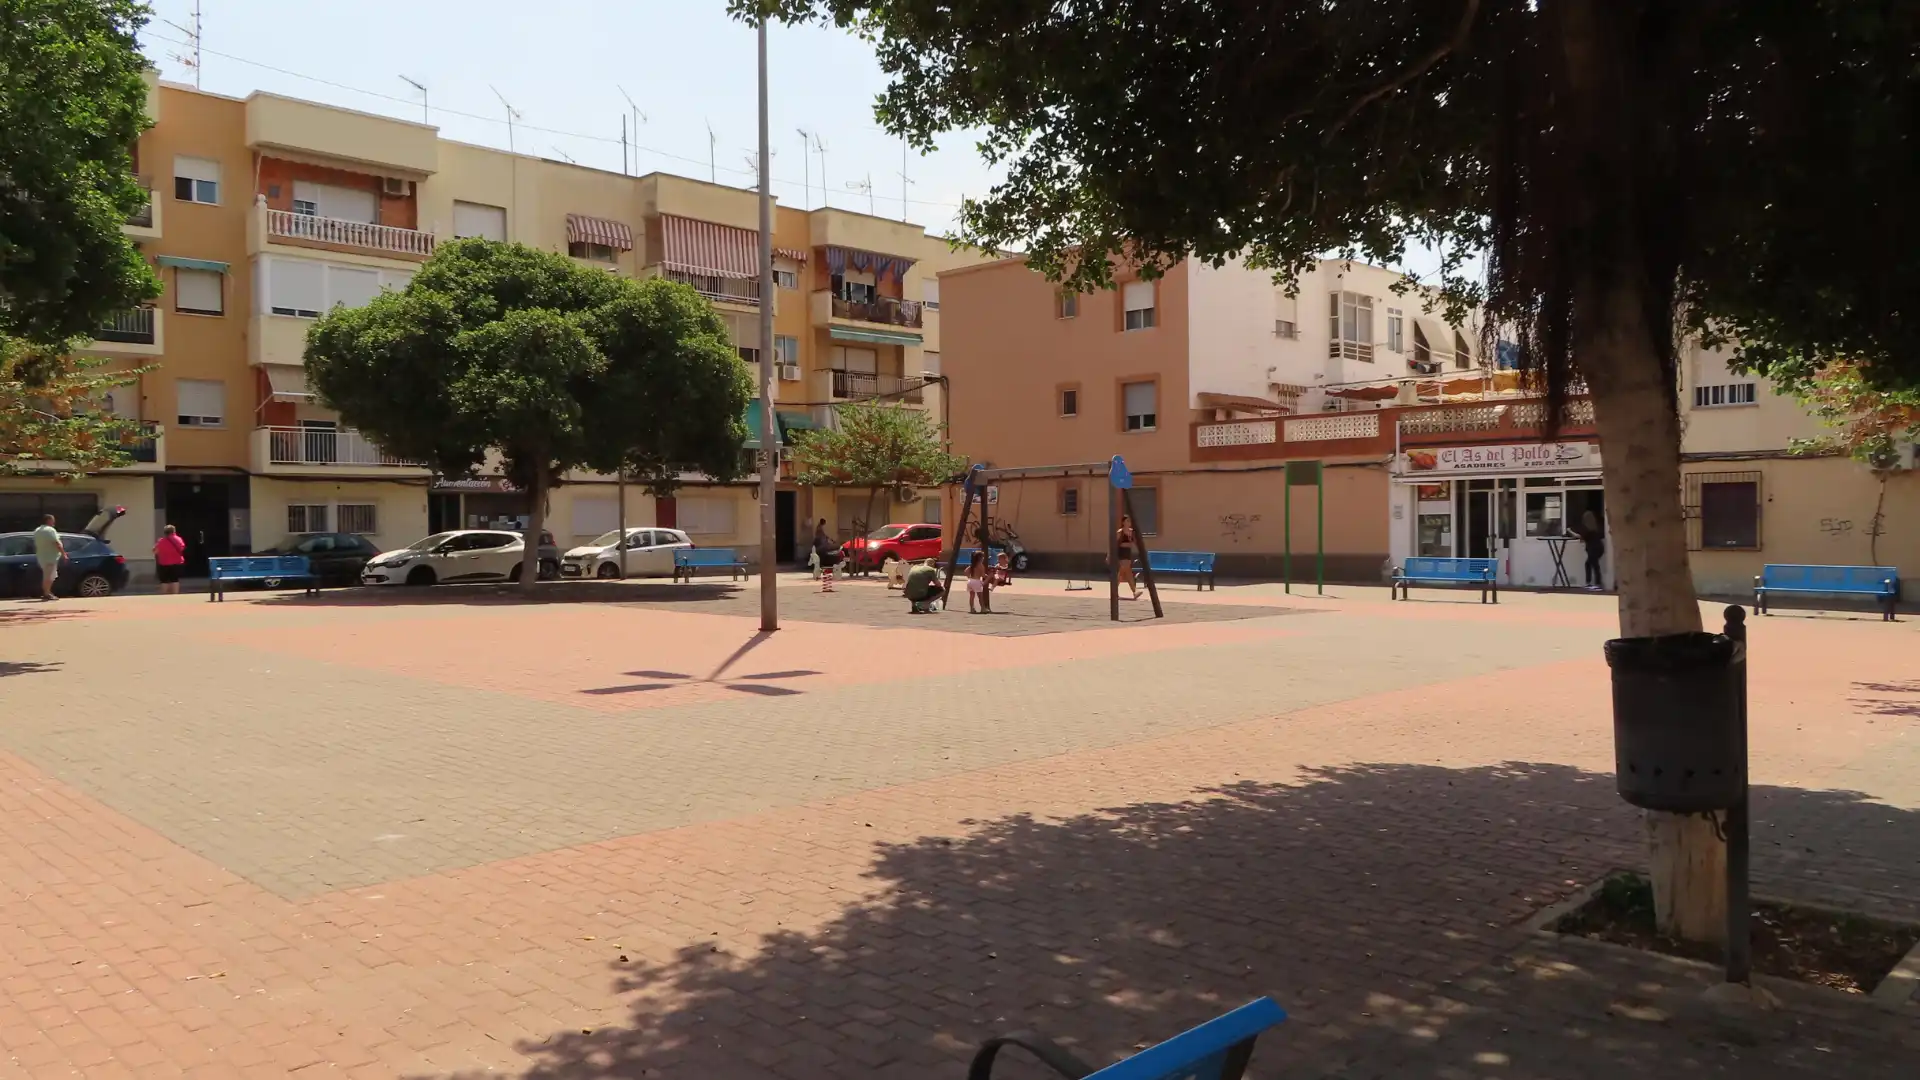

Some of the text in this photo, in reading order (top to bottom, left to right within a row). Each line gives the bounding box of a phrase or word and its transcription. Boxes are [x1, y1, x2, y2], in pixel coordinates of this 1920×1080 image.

[1441, 446, 1550, 463] El As del Pollo
